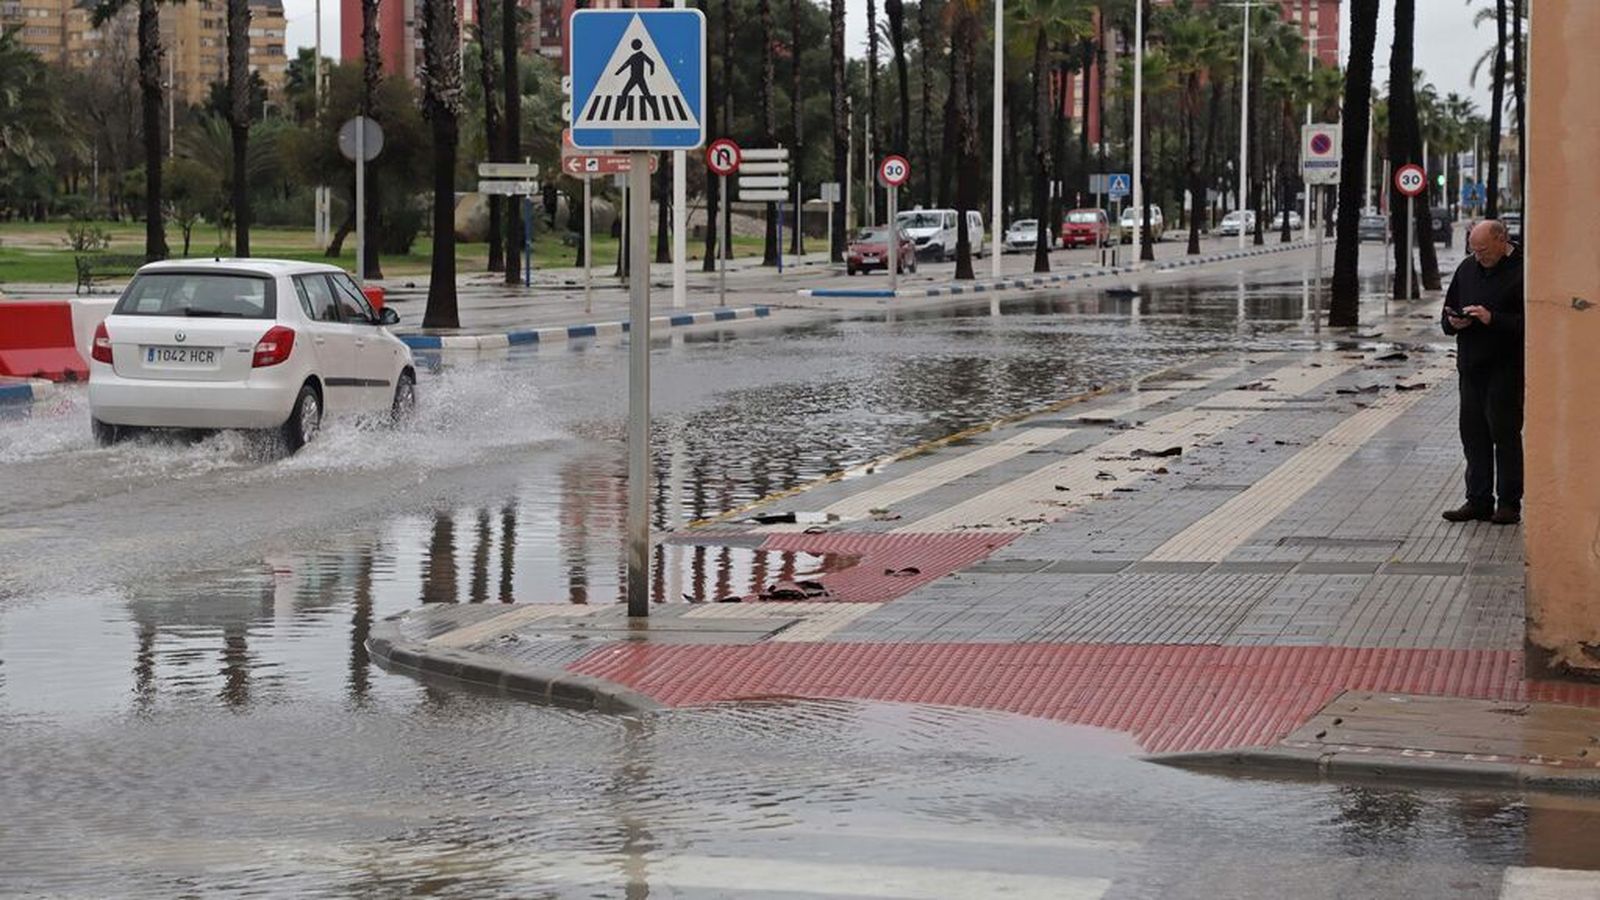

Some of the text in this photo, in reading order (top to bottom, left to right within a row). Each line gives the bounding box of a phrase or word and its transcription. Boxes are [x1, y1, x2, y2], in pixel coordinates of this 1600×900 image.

[886, 165, 903, 176] 30
[1402, 174, 1420, 185] 30
[157, 350, 215, 363] 1042 HCR
